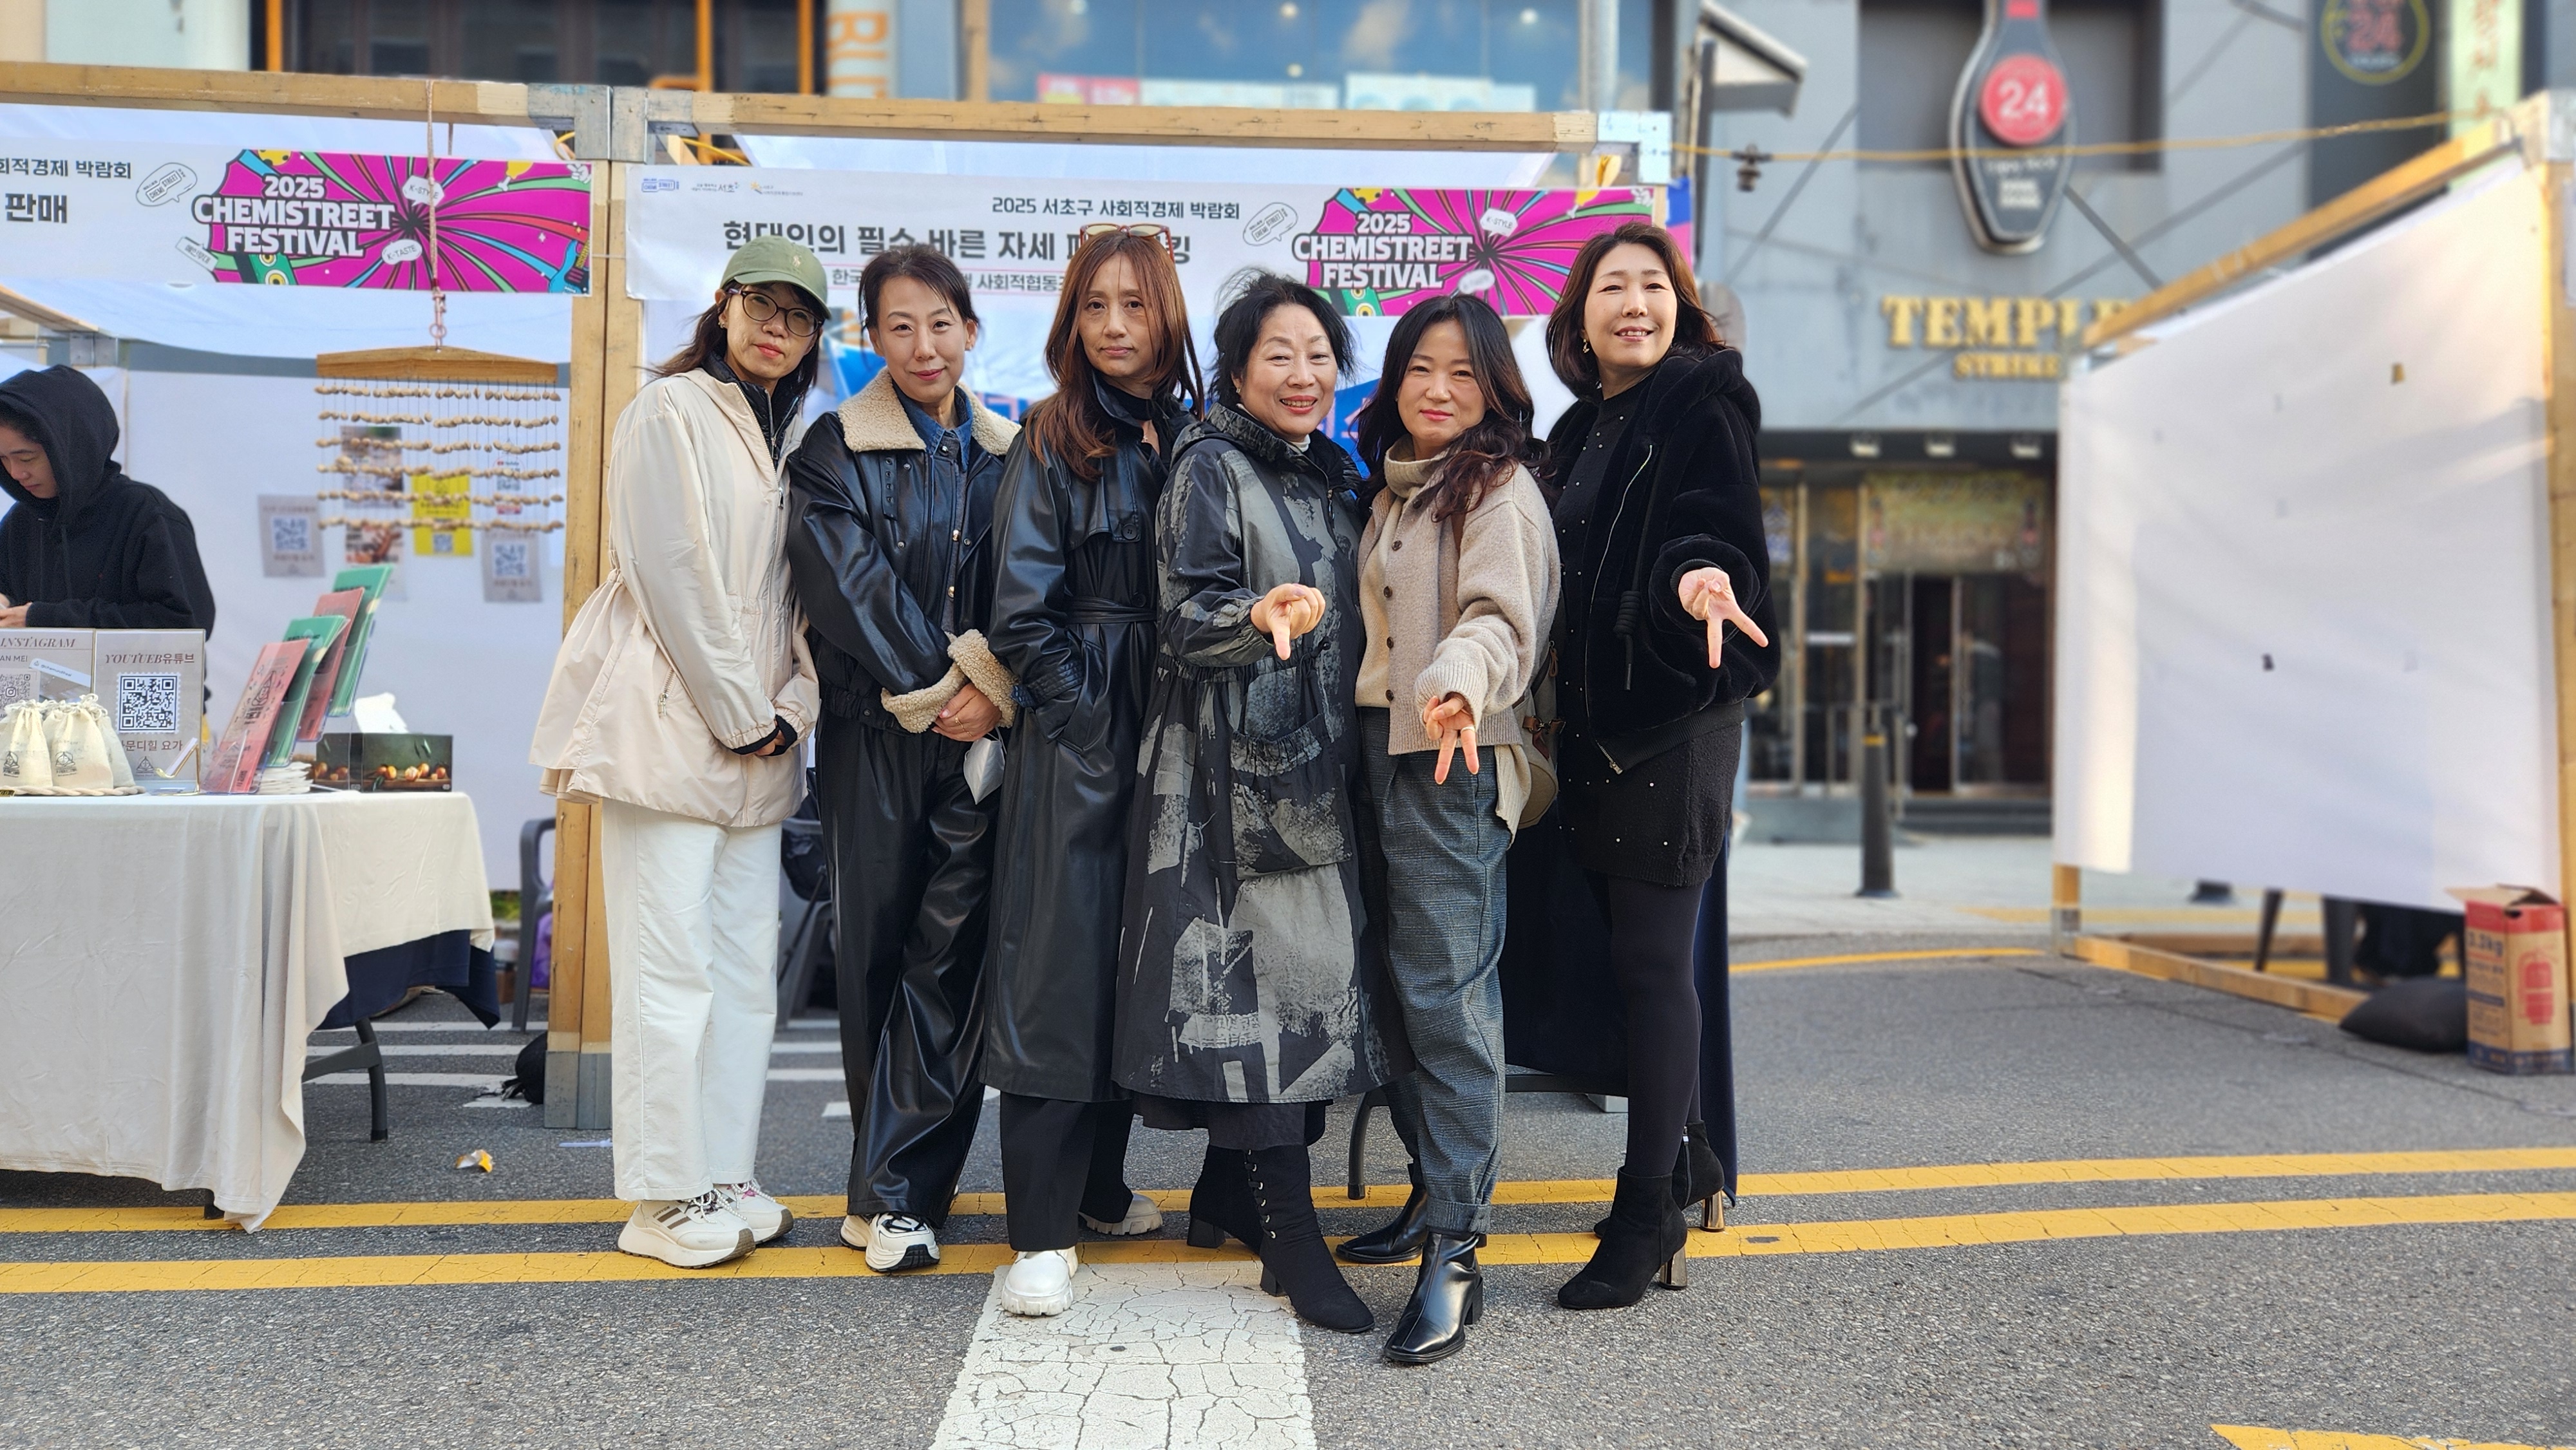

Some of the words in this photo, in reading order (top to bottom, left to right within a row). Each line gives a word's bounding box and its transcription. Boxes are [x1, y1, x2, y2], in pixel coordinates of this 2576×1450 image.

[1998, 78, 2049, 118] 24
[75, 160, 131, 180] 박람회
[162, 173, 178, 187] STREET
[264, 176, 325, 198] 2025
[409, 184, 439, 200] K-STYE
[5, 193, 67, 223] 판매
[193, 195, 396, 231] CHEMISTREET
[992, 197, 1036, 214] 2025
[1042, 198, 1094, 216] 서초구
[1099, 199, 1184, 219] 사회적경제
[1189, 202, 1240, 220] 박람회
[1357, 212, 1411, 234] 2025
[1486, 216, 1513, 229] K-STYLE
[227, 225, 364, 257] FESTIVAL
[929, 229, 985, 259] 바른
[998, 231, 1055, 260] 자세
[1293, 235, 1473, 261] CHEMISTREET
[386, 244, 417, 261] K-TASTE
[1323, 263, 1443, 288] FESTIVAL
[0, 636, 76, 648] INSTAGRAM
[105, 652, 195, 664] YOUTUEB유튜브
[161, 740, 184, 751] 요가
